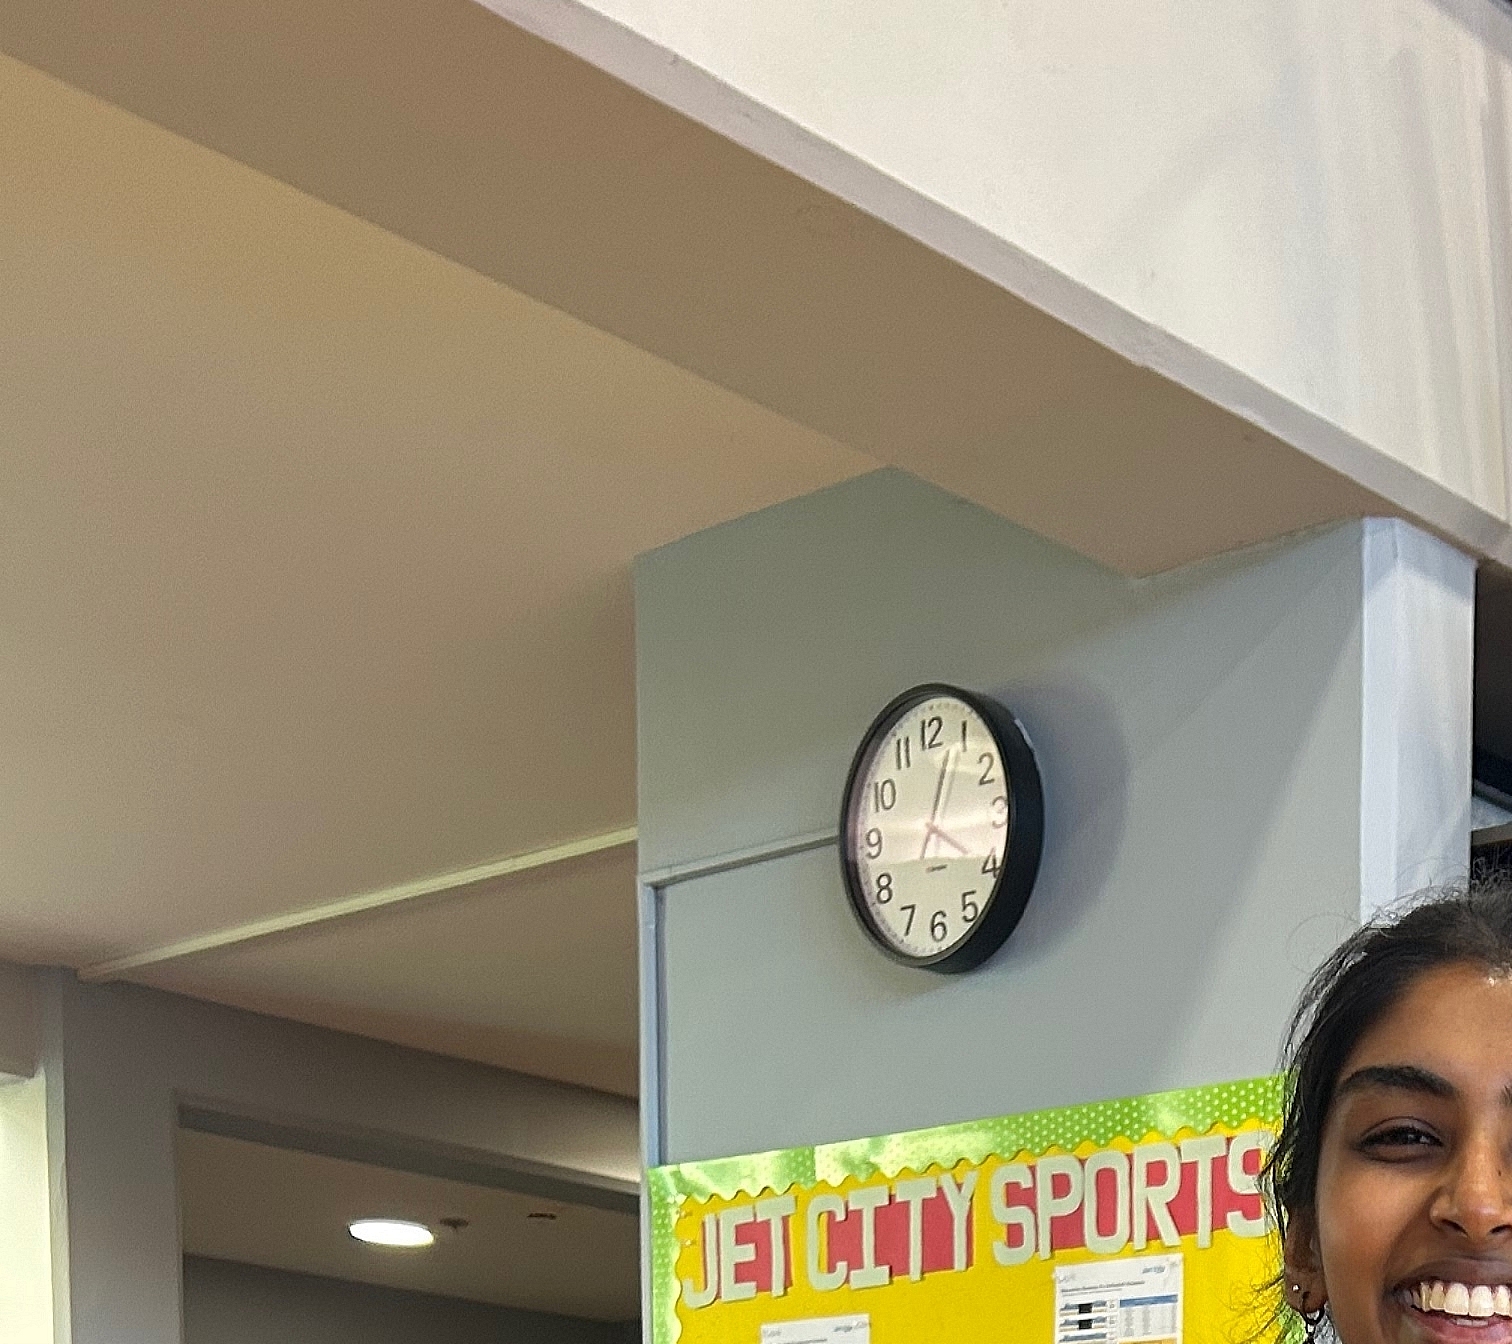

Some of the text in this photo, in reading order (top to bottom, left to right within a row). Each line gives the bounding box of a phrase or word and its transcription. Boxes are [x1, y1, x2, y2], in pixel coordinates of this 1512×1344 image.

[920, 716, 943, 750] 12
[960, 720, 968, 752] 1
[895, 736, 911, 770] 11
[977, 752, 995, 785] 2
[873, 778, 896, 812] 10
[991, 795, 1008, 829] 3
[865, 827, 882, 859] 9
[981, 847, 1000, 878] 4
[876, 872, 893, 904] 8
[900, 904, 917, 936] 7
[961, 890, 978, 924] 5
[929, 910, 947, 942] 6
[683, 1130, 1274, 1309] JET CITY SPORTS
